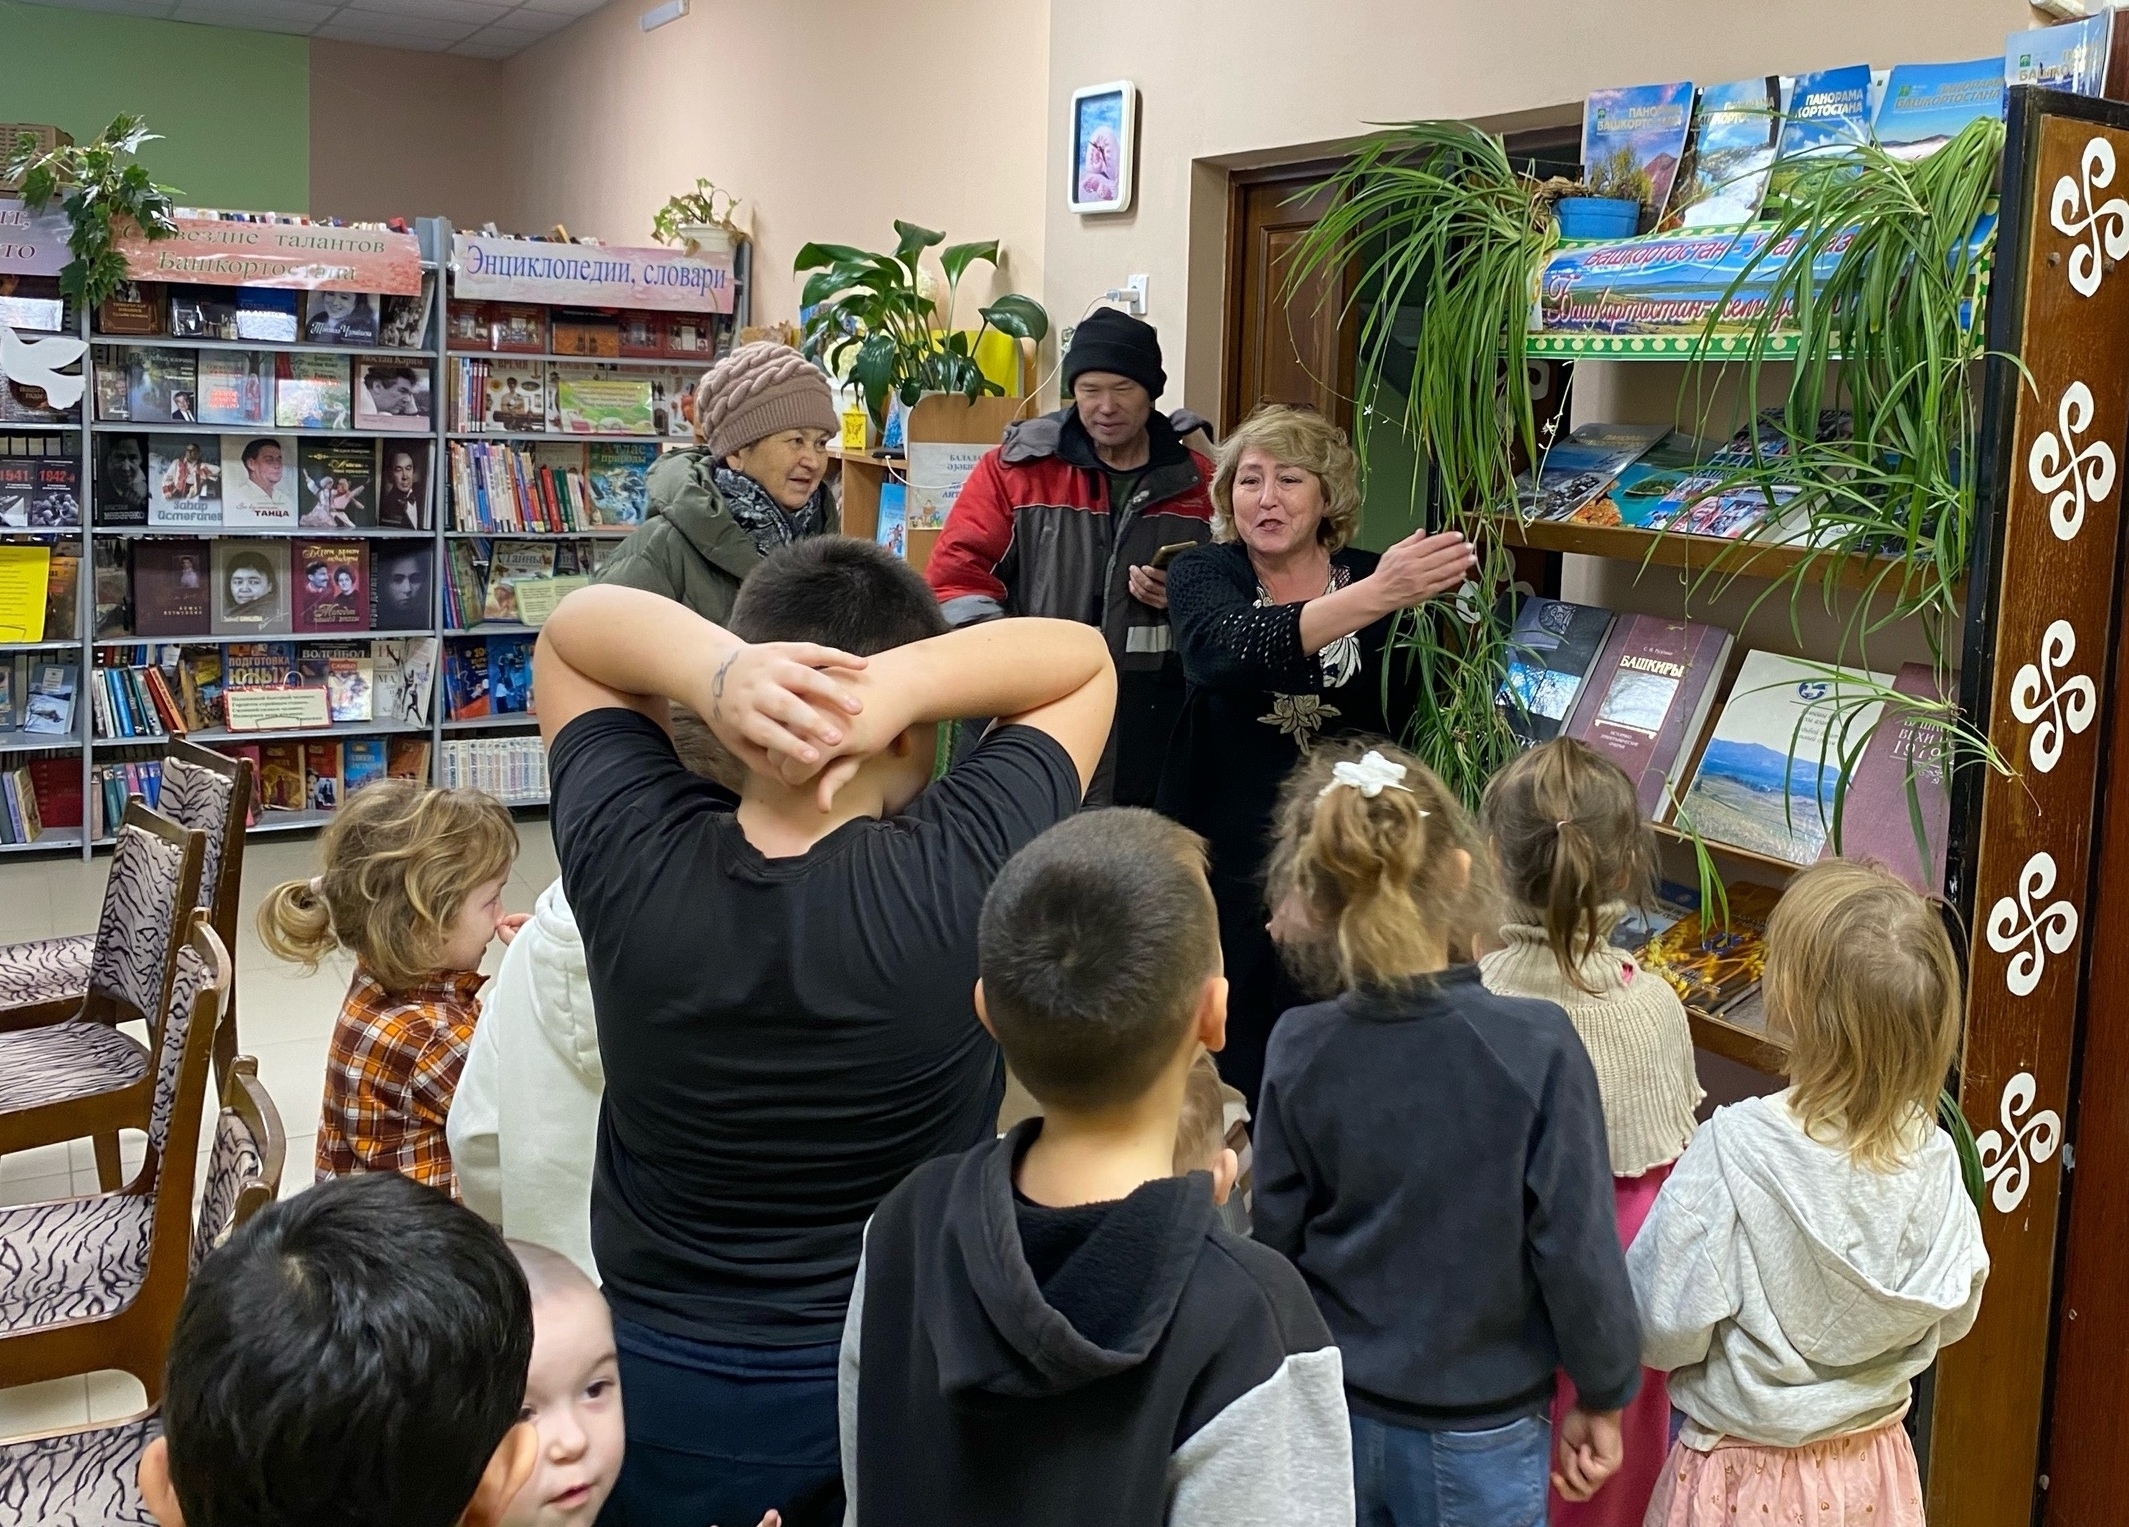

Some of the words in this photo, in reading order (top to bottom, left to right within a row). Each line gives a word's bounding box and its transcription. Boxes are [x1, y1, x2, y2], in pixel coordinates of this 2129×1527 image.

[1806, 88, 1863, 106] ПАНОРАМА
[122, 222, 260, 244] Свездие
[275, 234, 385, 253] талантов
[159, 250, 356, 280] Башкортостана
[467, 245, 636, 288] Энциклопедии,
[643, 263, 727, 296] словари
[601, 443, 646, 455] Атлас
[601, 454, 647, 465] природы
[255, 510, 290, 518] ТАНЦА
[228, 656, 290, 667] ПОДГОТОВКА
[302, 649, 366, 659] ВОЛЕЙБОЛ
[1620, 654, 1685, 678] БАШКИРЫ
[228, 666, 291, 686] ЮНЫХ
